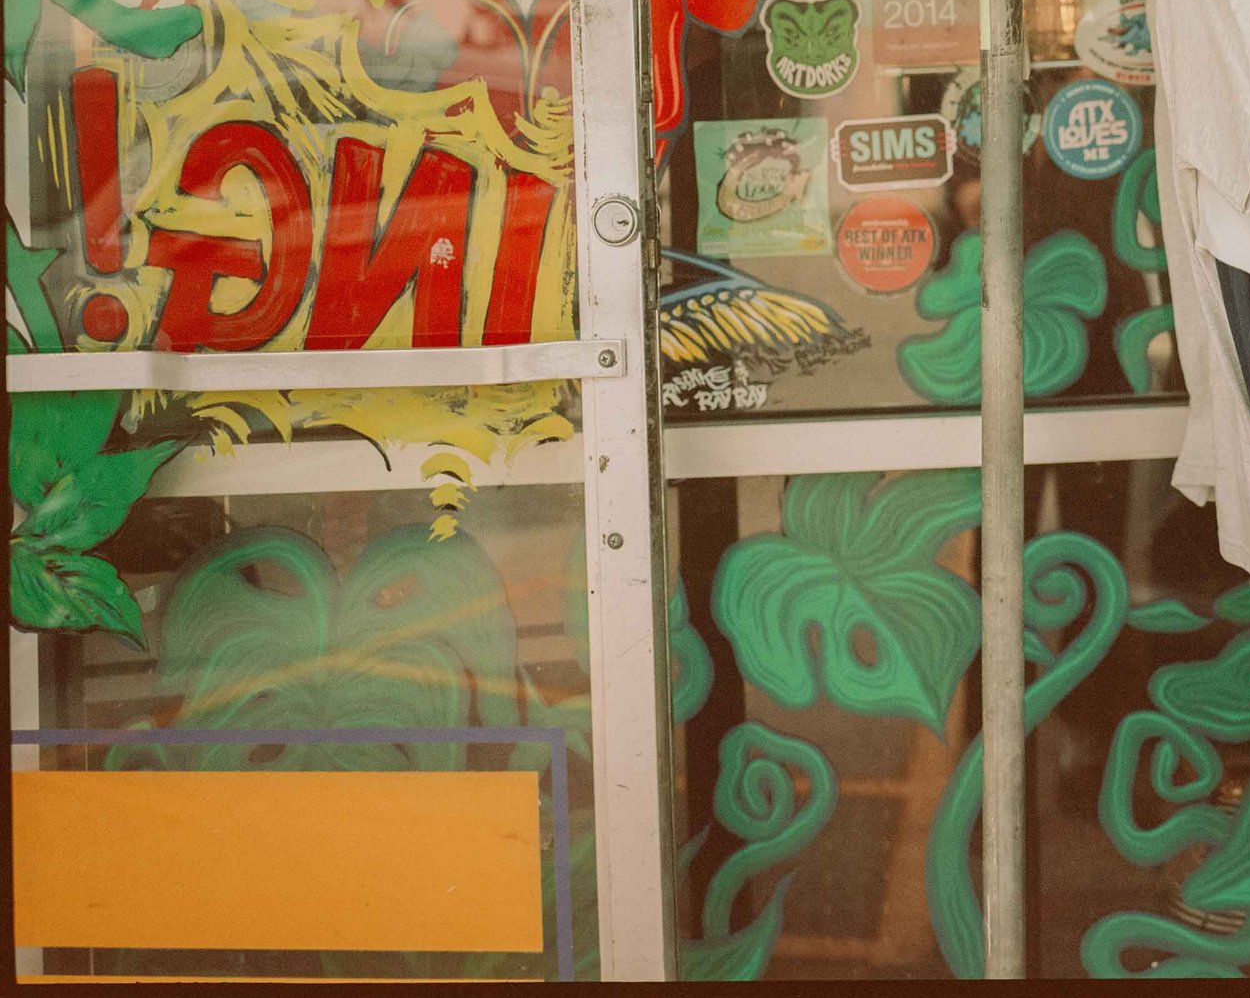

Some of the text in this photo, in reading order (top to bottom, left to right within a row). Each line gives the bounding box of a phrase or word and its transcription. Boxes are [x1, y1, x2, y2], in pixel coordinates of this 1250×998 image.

[1068, 99, 1115, 125] ATX
[850, 125, 937, 163] SIMS
[1058, 119, 1129, 151] LOVES
[845, 229, 877, 243] BEST
[881, 229, 896, 243] OF
